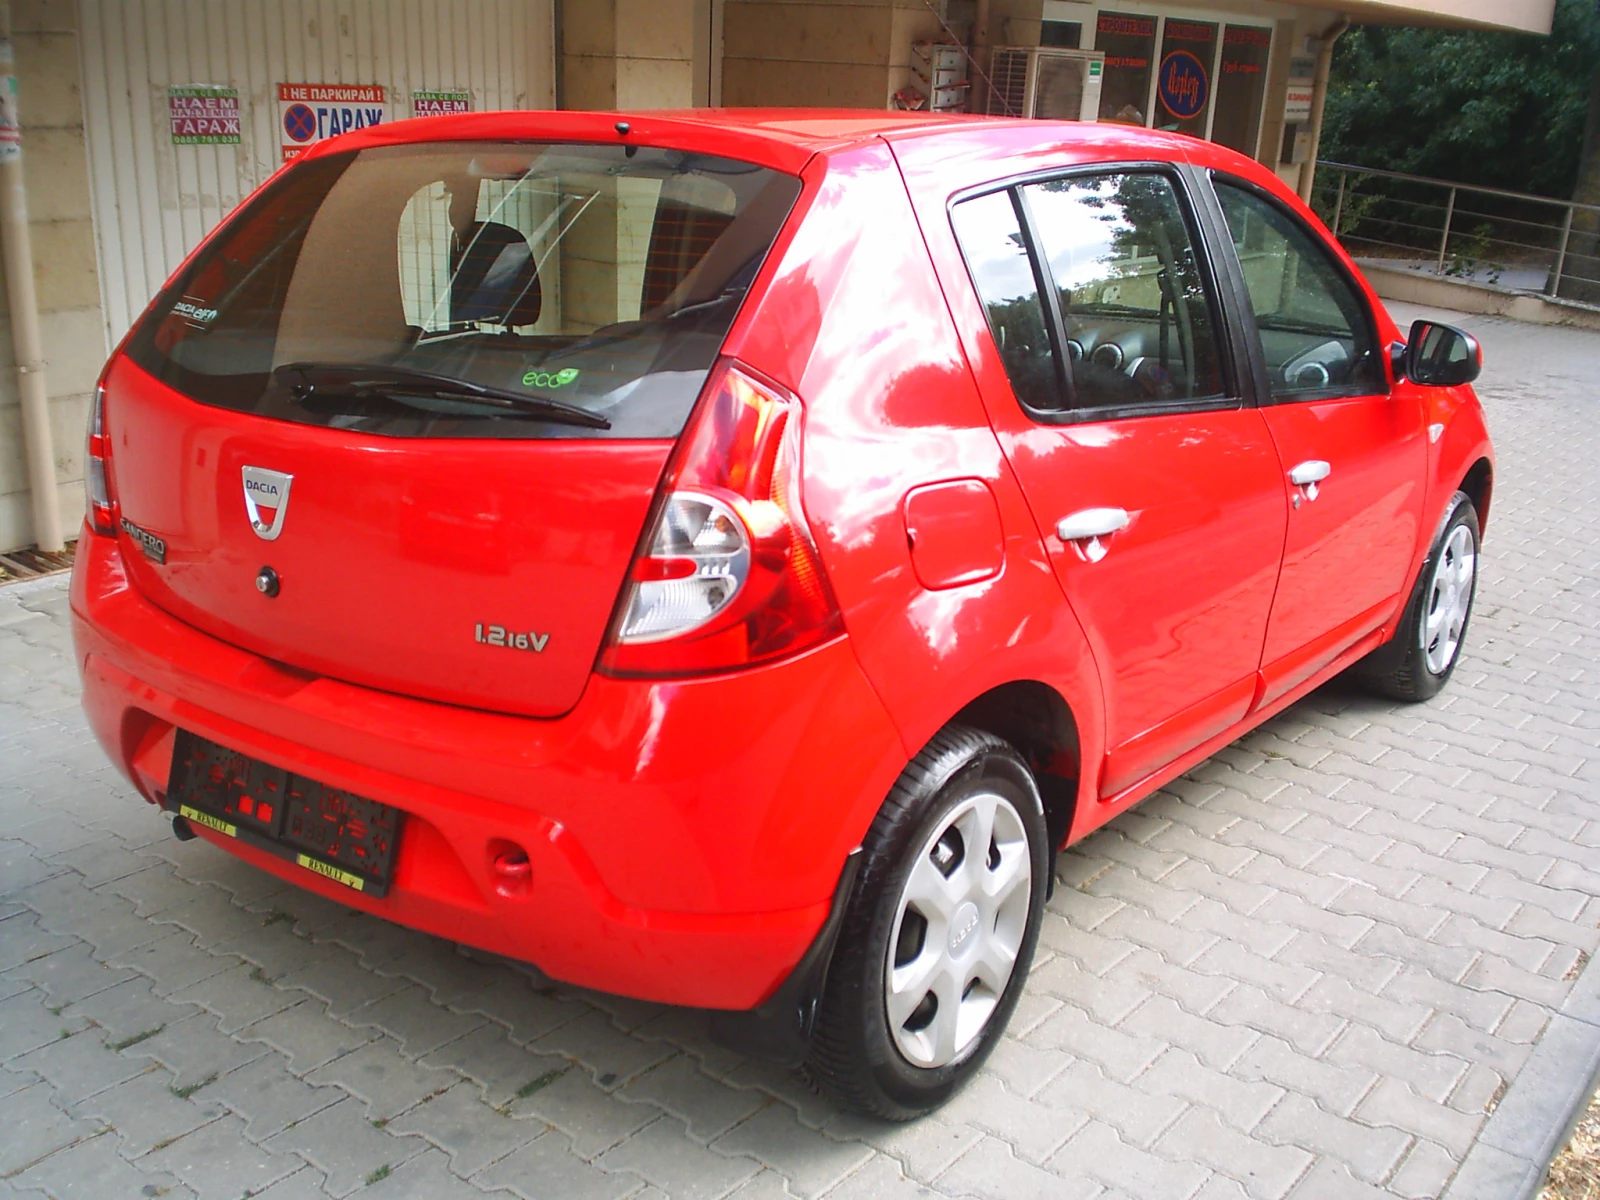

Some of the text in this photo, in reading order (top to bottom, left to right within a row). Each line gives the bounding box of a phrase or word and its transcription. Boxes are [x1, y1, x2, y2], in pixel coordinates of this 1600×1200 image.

[291, 88, 308, 99] НЕ
[311, 87, 374, 101] ПАРКИРАЙ
[173, 98, 235, 108] НАЕМ
[418, 100, 465, 110] НАЕМ
[172, 119, 239, 134] ГАРАЖ
[317, 107, 382, 139] ГАРАЖ
[522, 371, 561, 388] eco
[245, 479, 278, 496] DACIA
[120, 517, 165, 554] SANDERO
[196, 812, 229, 833] RENAULT
[308, 857, 345, 882] RENAULT
